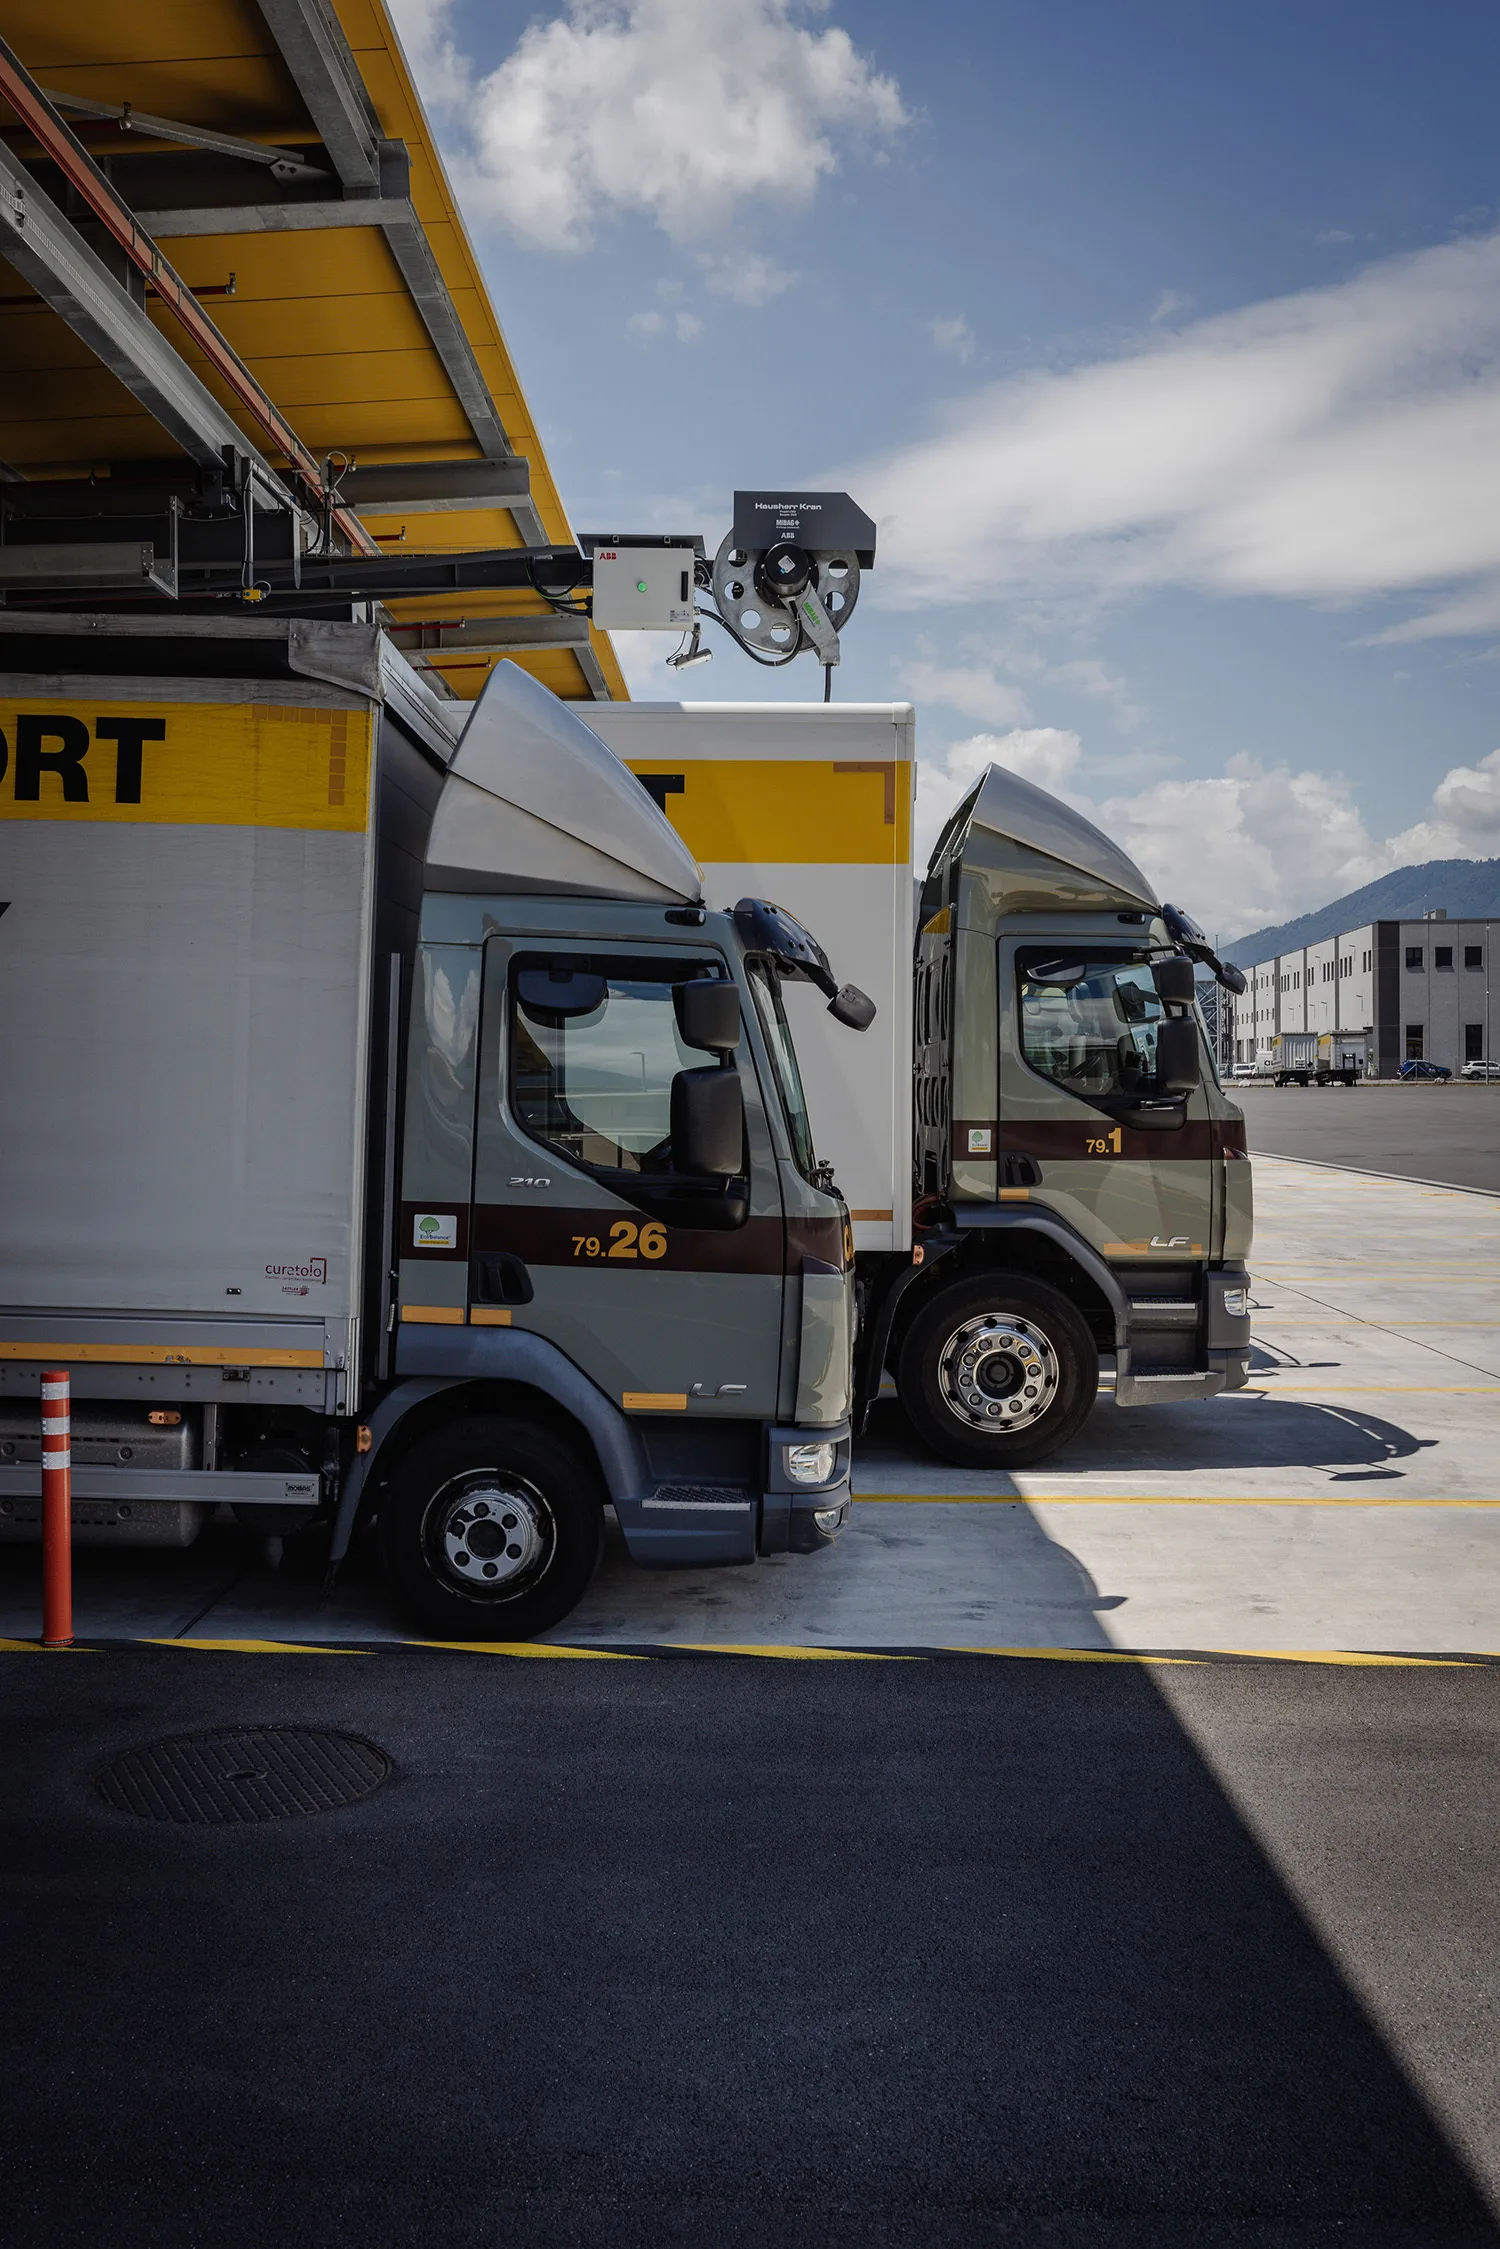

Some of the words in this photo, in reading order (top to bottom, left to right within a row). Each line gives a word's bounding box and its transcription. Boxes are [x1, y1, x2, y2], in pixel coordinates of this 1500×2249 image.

[799, 503, 822, 511] Kran
[599, 552, 617, 560] ABB
[0, 714, 166, 804] RT
[1085, 1127, 1122, 1153] 79.1
[506, 1176, 551, 1189] 210
[571, 1220, 668, 1259] 79.26
[1150, 1235, 1189, 1247] LF
[689, 1382, 748, 1398] LF
